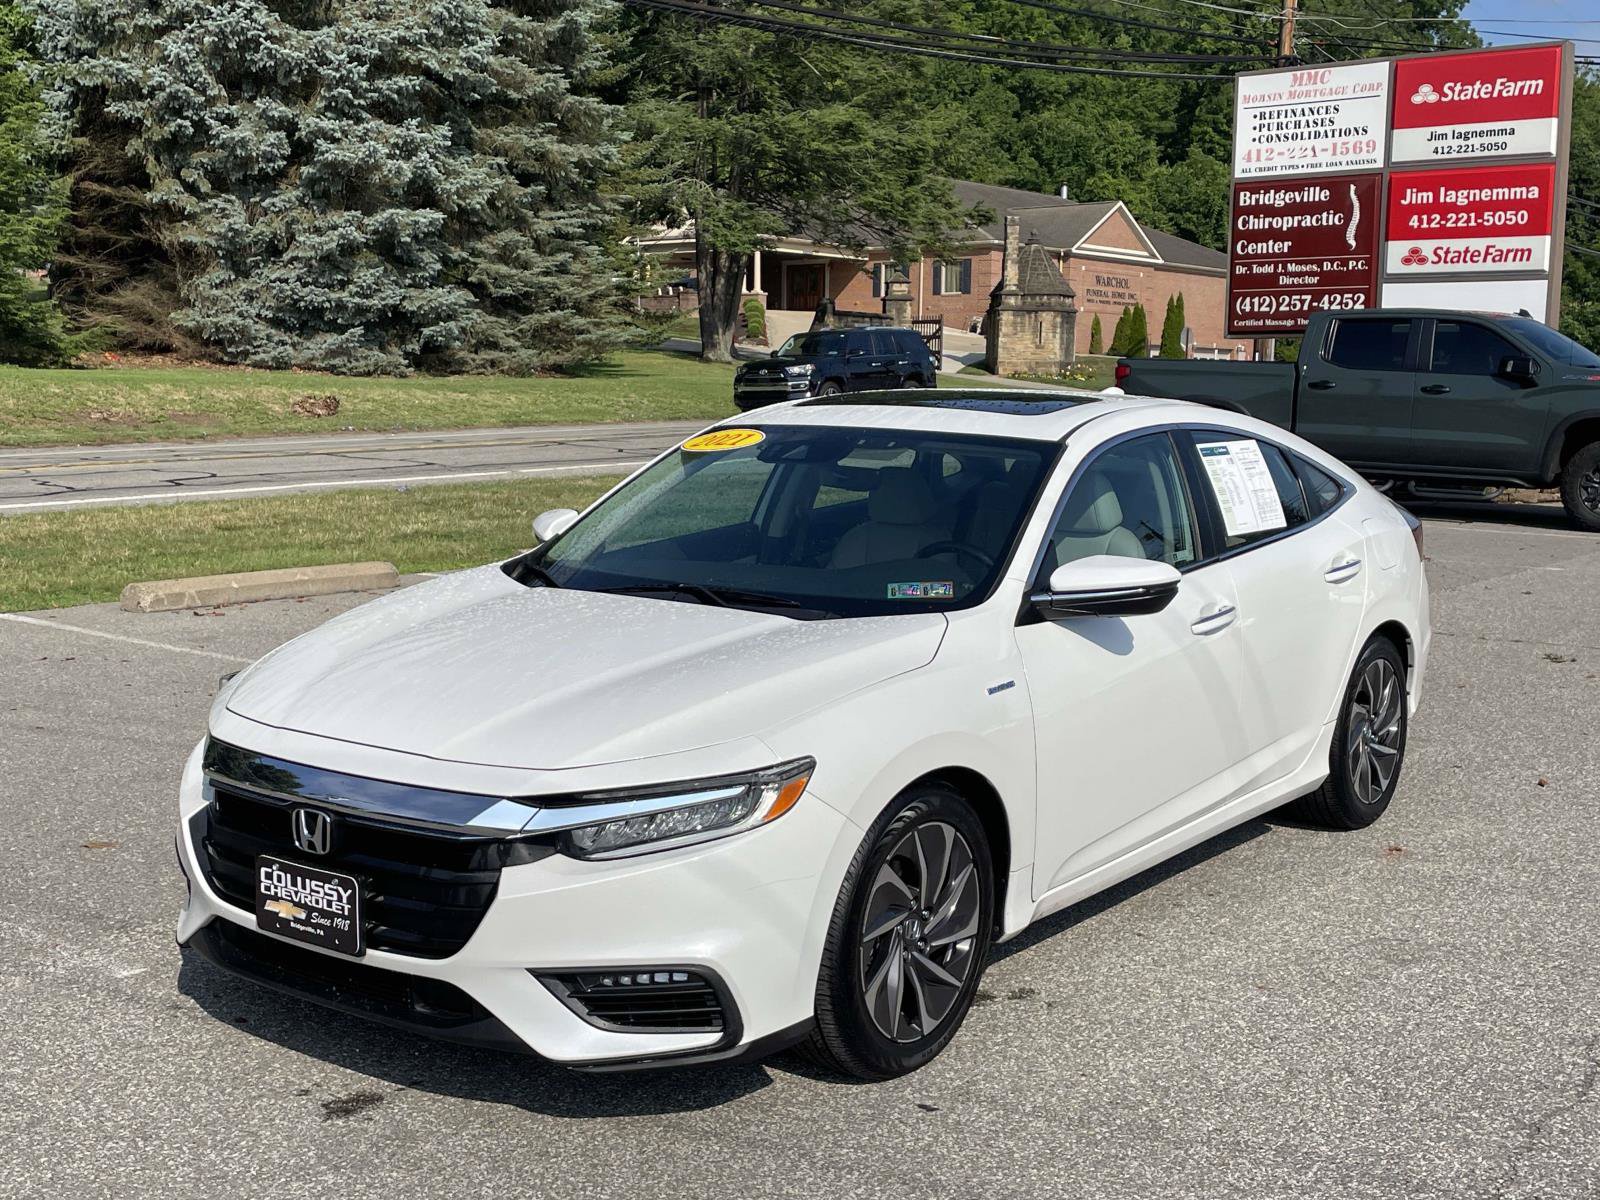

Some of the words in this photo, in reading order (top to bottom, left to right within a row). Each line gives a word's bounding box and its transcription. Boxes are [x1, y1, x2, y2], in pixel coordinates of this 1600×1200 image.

[1290, 69, 1332, 87] MMC
[1287, 85, 1348, 100] MORTGAGE
[1259, 105, 1340, 121] REFINANCES
[1258, 117, 1335, 132] PURCHASES
[1258, 126, 1368, 144] CONSOLIDATIONS
[1427, 131, 1448, 142] Jim
[1432, 141, 1507, 155] 412-221-5050
[1239, 186, 1330, 207] Bridgeville
[1400, 188, 1433, 205] Jim
[1238, 210, 1344, 231] Chiropractic
[1409, 210, 1528, 229] 412-221-5050
[1236, 239, 1292, 255] Center
[1236, 265, 1249, 274] Dr.
[1252, 264, 1274, 273] Todd
[1277, 264, 1284, 272] J.
[1287, 263, 1320, 272] Moses,
[1349, 260, 1368, 270] P.C.
[1096, 275, 1130, 289] WARCHOL
[1280, 275, 1319, 285] Director
[1086, 289, 1110, 298] FUNERAL
[1112, 291, 1126, 299] HOME
[1236, 296, 1277, 315] (412)
[1279, 293, 1365, 311] 257-4252
[1234, 319, 1263, 327] Certified
[1265, 318, 1294, 327] Massage
[260, 866, 352, 904] COLUSSY
[260, 882, 351, 915] CHEVROLET
[310, 912, 331, 926] Since
[333, 917, 350, 931] 1918
